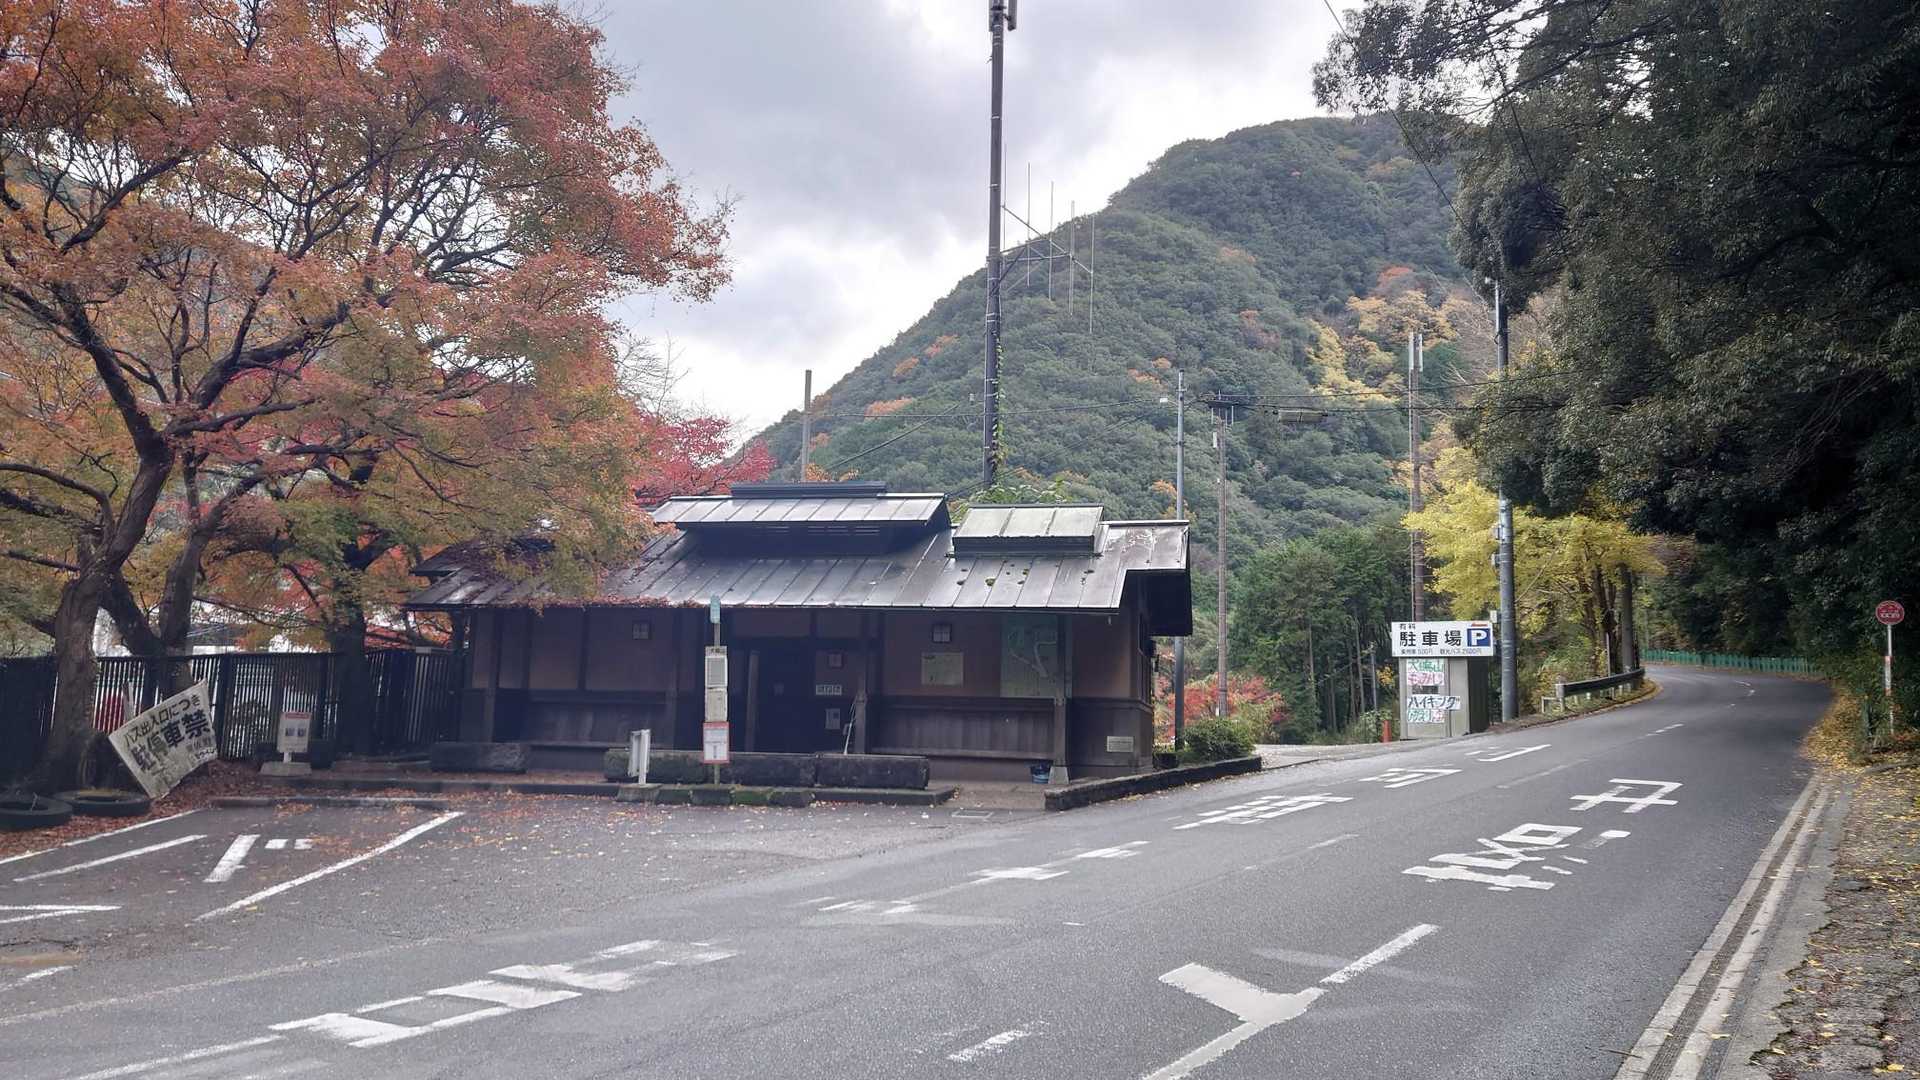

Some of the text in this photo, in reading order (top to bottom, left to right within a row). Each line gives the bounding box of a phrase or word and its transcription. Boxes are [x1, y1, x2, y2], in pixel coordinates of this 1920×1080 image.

[1400, 629, 1487, 647] 駐車場 P
[1408, 658, 1443, 672] 犬鳴山
[1408, 672, 1443, 685] もみじ
[1408, 696, 1460, 709] ハイキング
